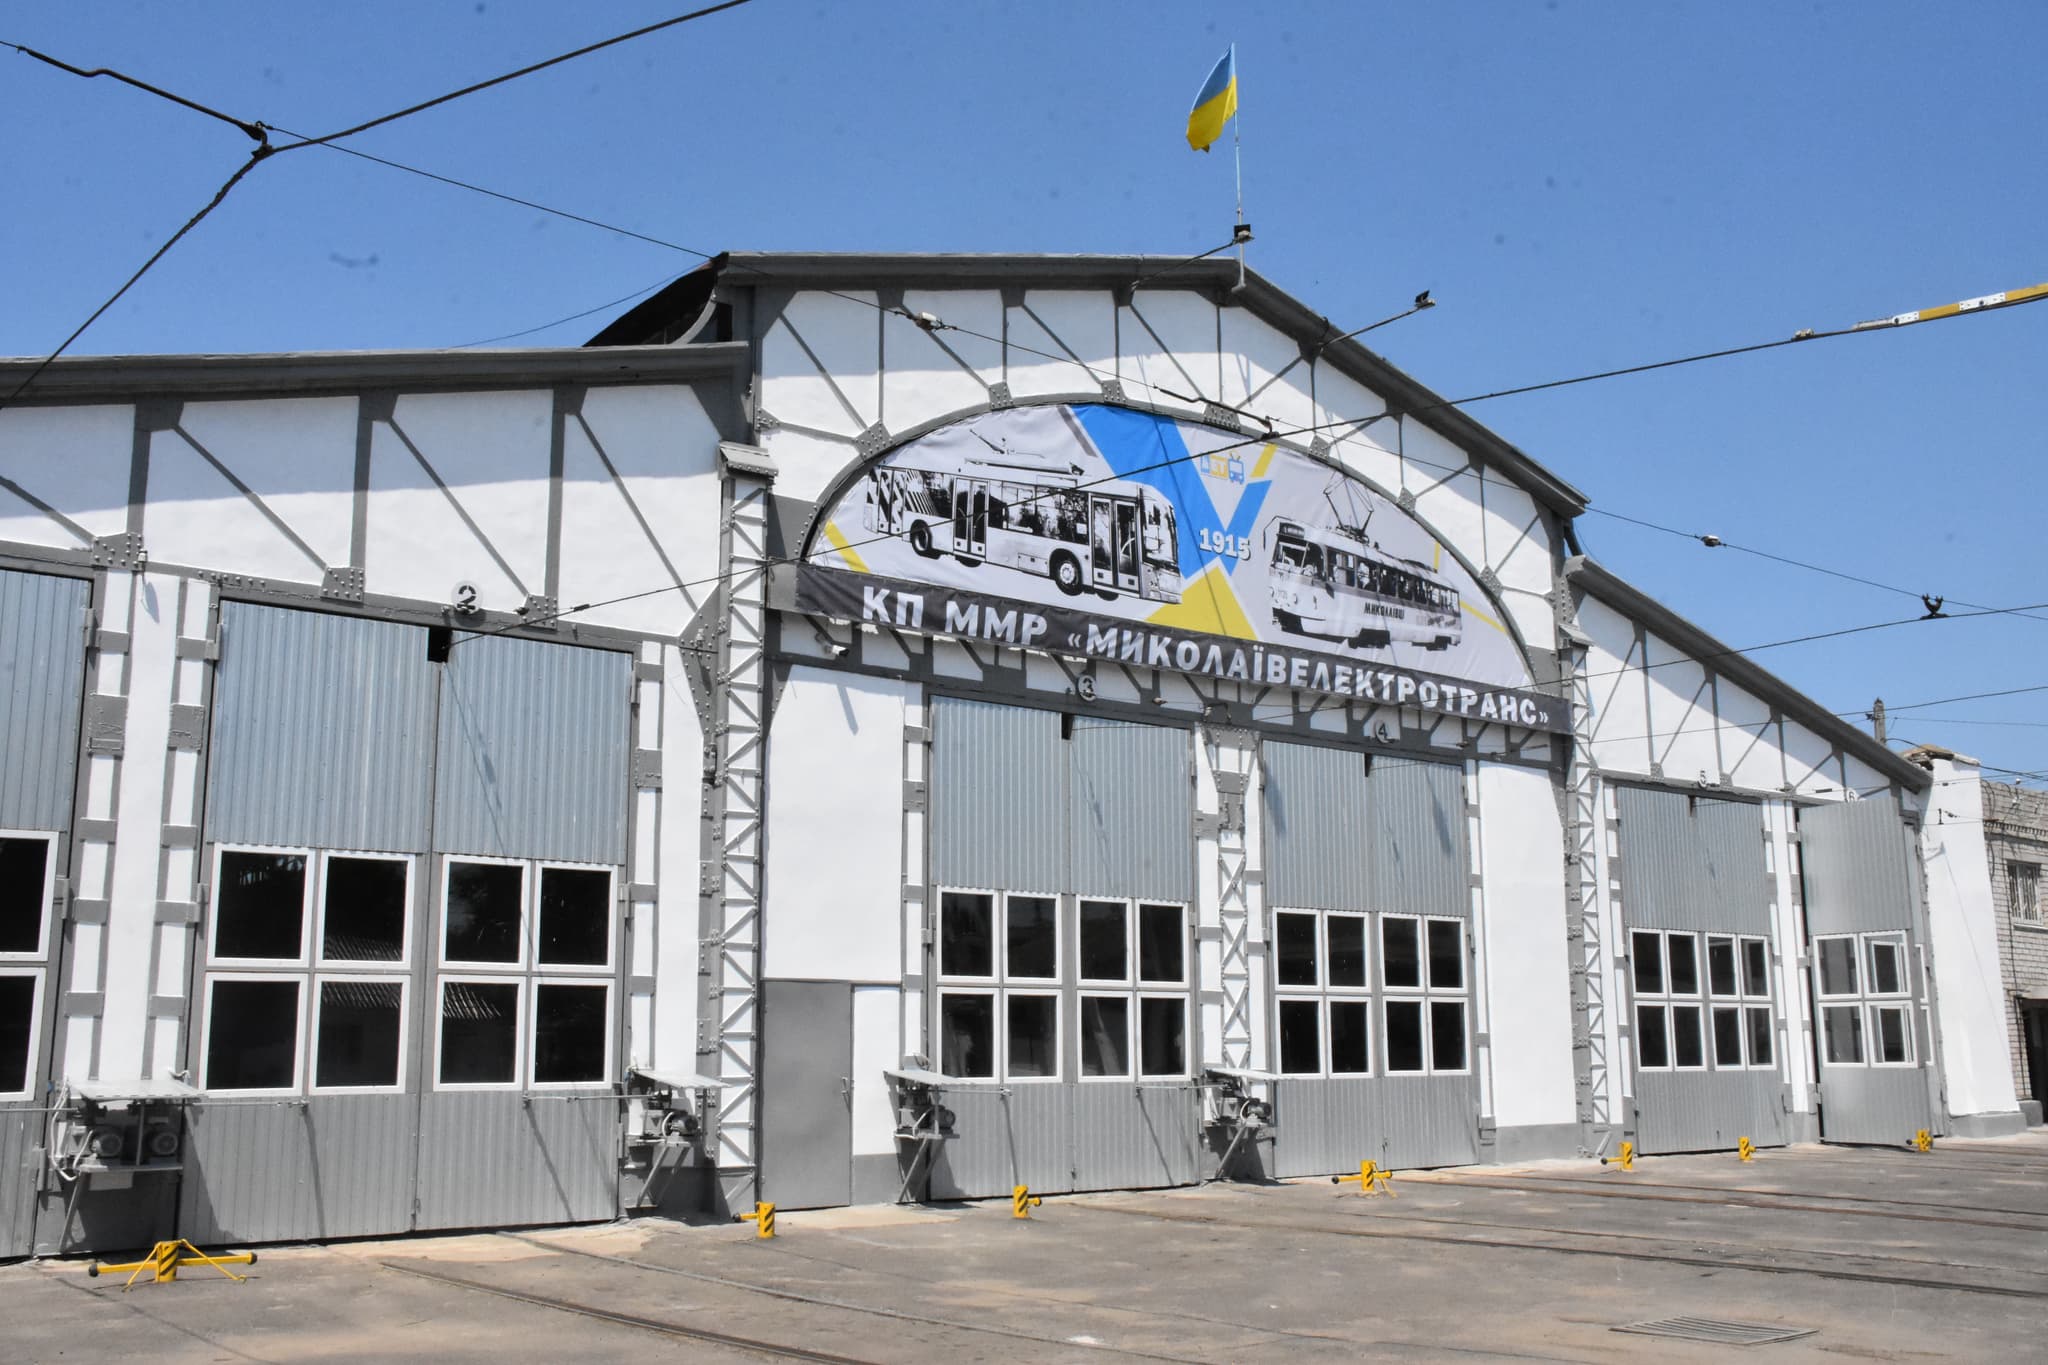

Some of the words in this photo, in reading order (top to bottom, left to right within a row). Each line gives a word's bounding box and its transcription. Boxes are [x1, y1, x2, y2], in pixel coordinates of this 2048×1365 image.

[1199, 527, 1252, 561] 1915
[457, 585, 476, 610] 2
[863, 585, 924, 628] КП
[945, 600, 1048, 645] ММР
[1067, 623, 1549, 725] «МИКОЛАЇВЕЛЕКТРОТРАНС»
[1081, 677, 1095, 698] 3
[1378, 722, 1388, 739] 4
